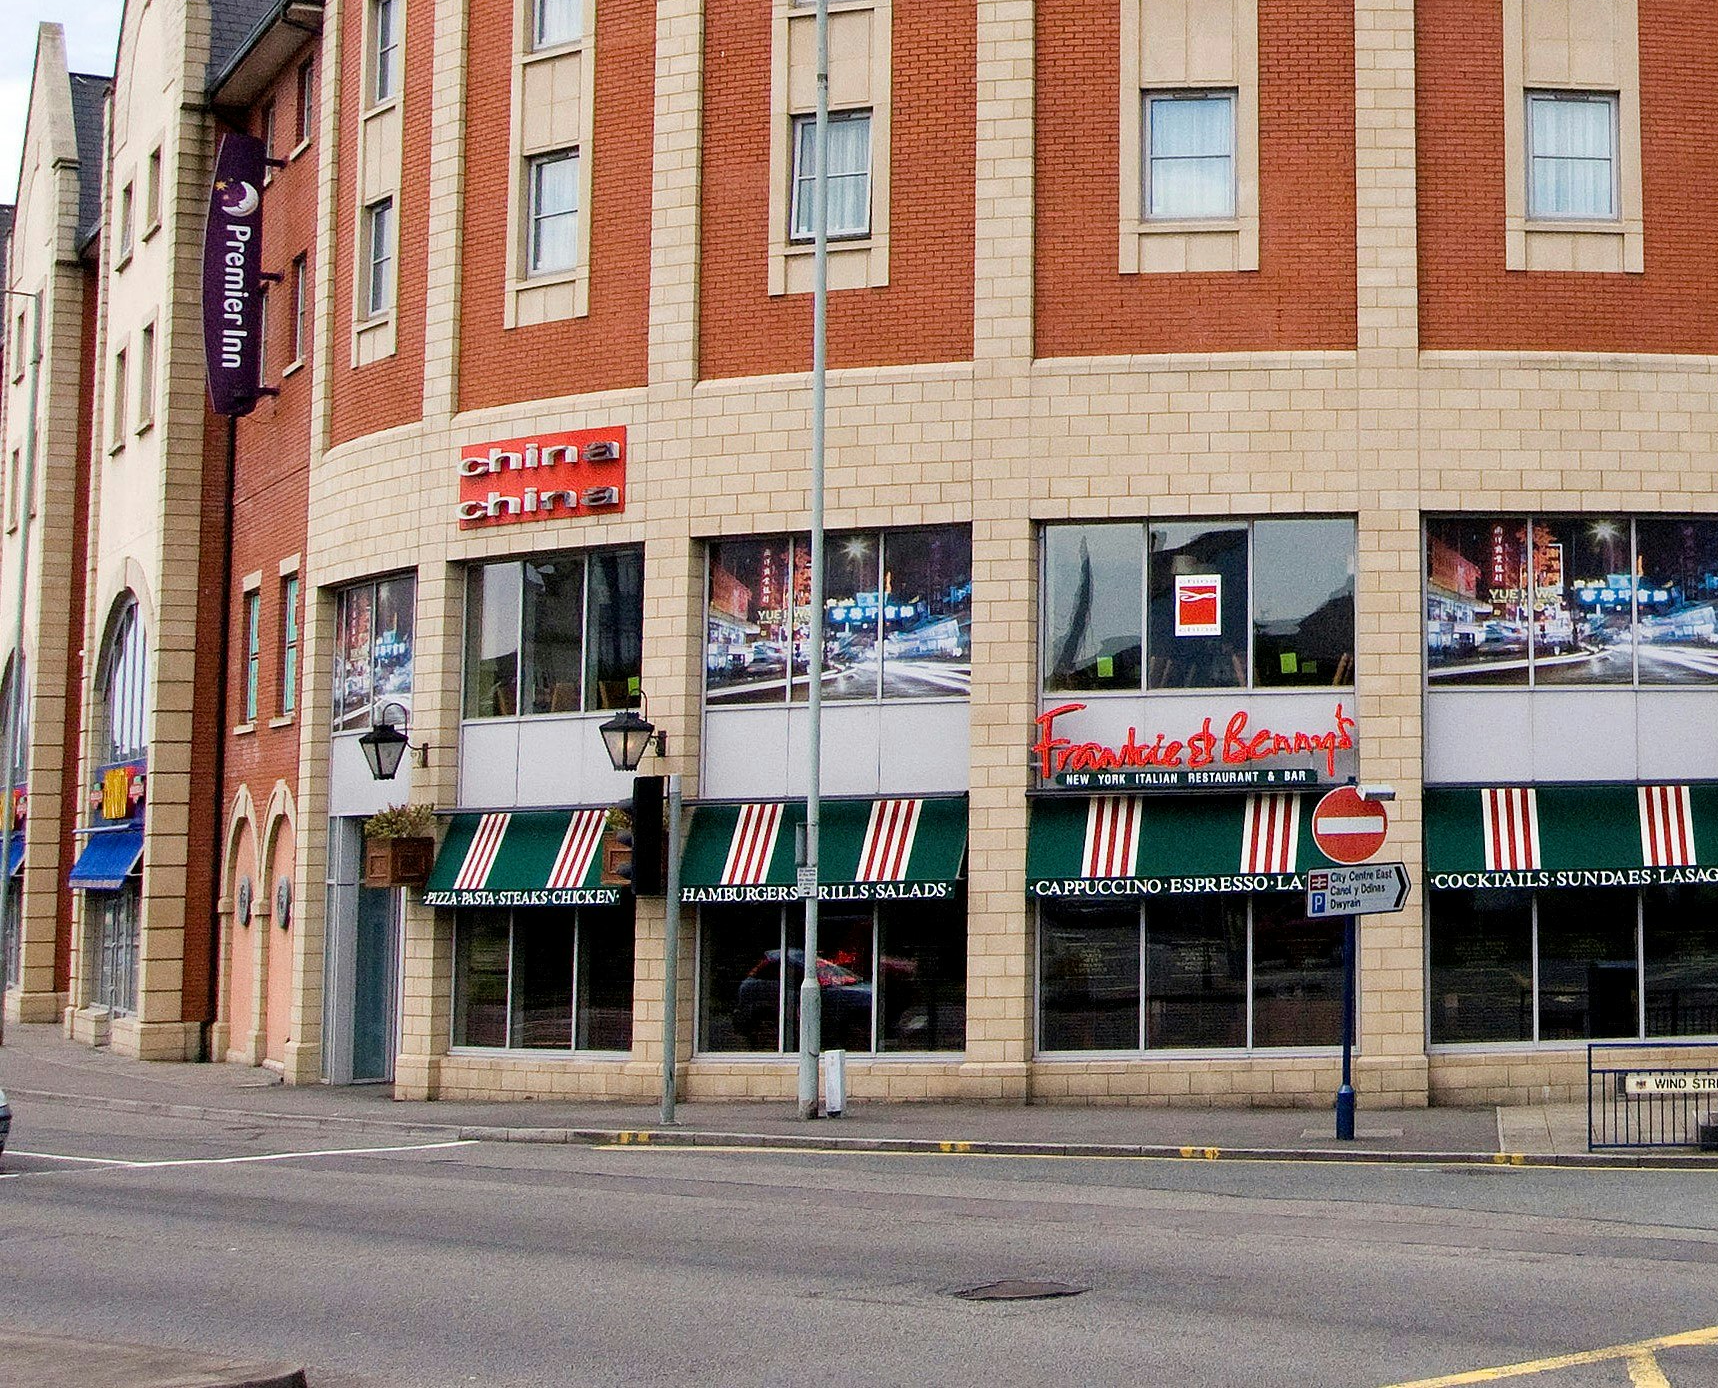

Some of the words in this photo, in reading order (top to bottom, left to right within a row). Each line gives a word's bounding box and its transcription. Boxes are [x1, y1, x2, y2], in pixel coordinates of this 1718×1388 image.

[223, 224, 252, 326] Premier
[221, 329, 248, 369] Inn
[456, 441, 620, 477] china
[455, 486, 619, 521] china
[1031, 703, 1183, 779] Frankie
[1222, 703, 1355, 777] Benny's
[1066, 774, 1090, 785] NEW
[1097, 773, 1126, 785] YORK
[1135, 772, 1178, 784] ITALIAN
[1187, 770, 1261, 783] RESTAURANT
[1267, 770, 1276, 782] &
[1283, 769, 1307, 782] BAR
[1035, 878, 1162, 896] CAPPUCCINO
[1170, 876, 1268, 894] ESPRESSO
[1275, 874, 1307, 891] LA
[1330, 872, 1347, 884] City
[1349, 870, 1374, 881] Centre
[1375, 869, 1393, 879] East
[1433, 872, 1550, 889] COCKTAILS
[1556, 870, 1651, 887] SUNDAES
[425, 891, 458, 906] PIZZA
[459, 890, 495, 906] PASTA
[499, 890, 549, 906] STEAKS
[552, 889, 616, 905] CHICKEN
[681, 885, 799, 902] HAMBURGERS
[816, 884, 870, 900] RILLS
[875, 882, 947, 900] SALADS
[1314, 894, 1323, 911] P
[1654, 1078, 1687, 1089] WIND
